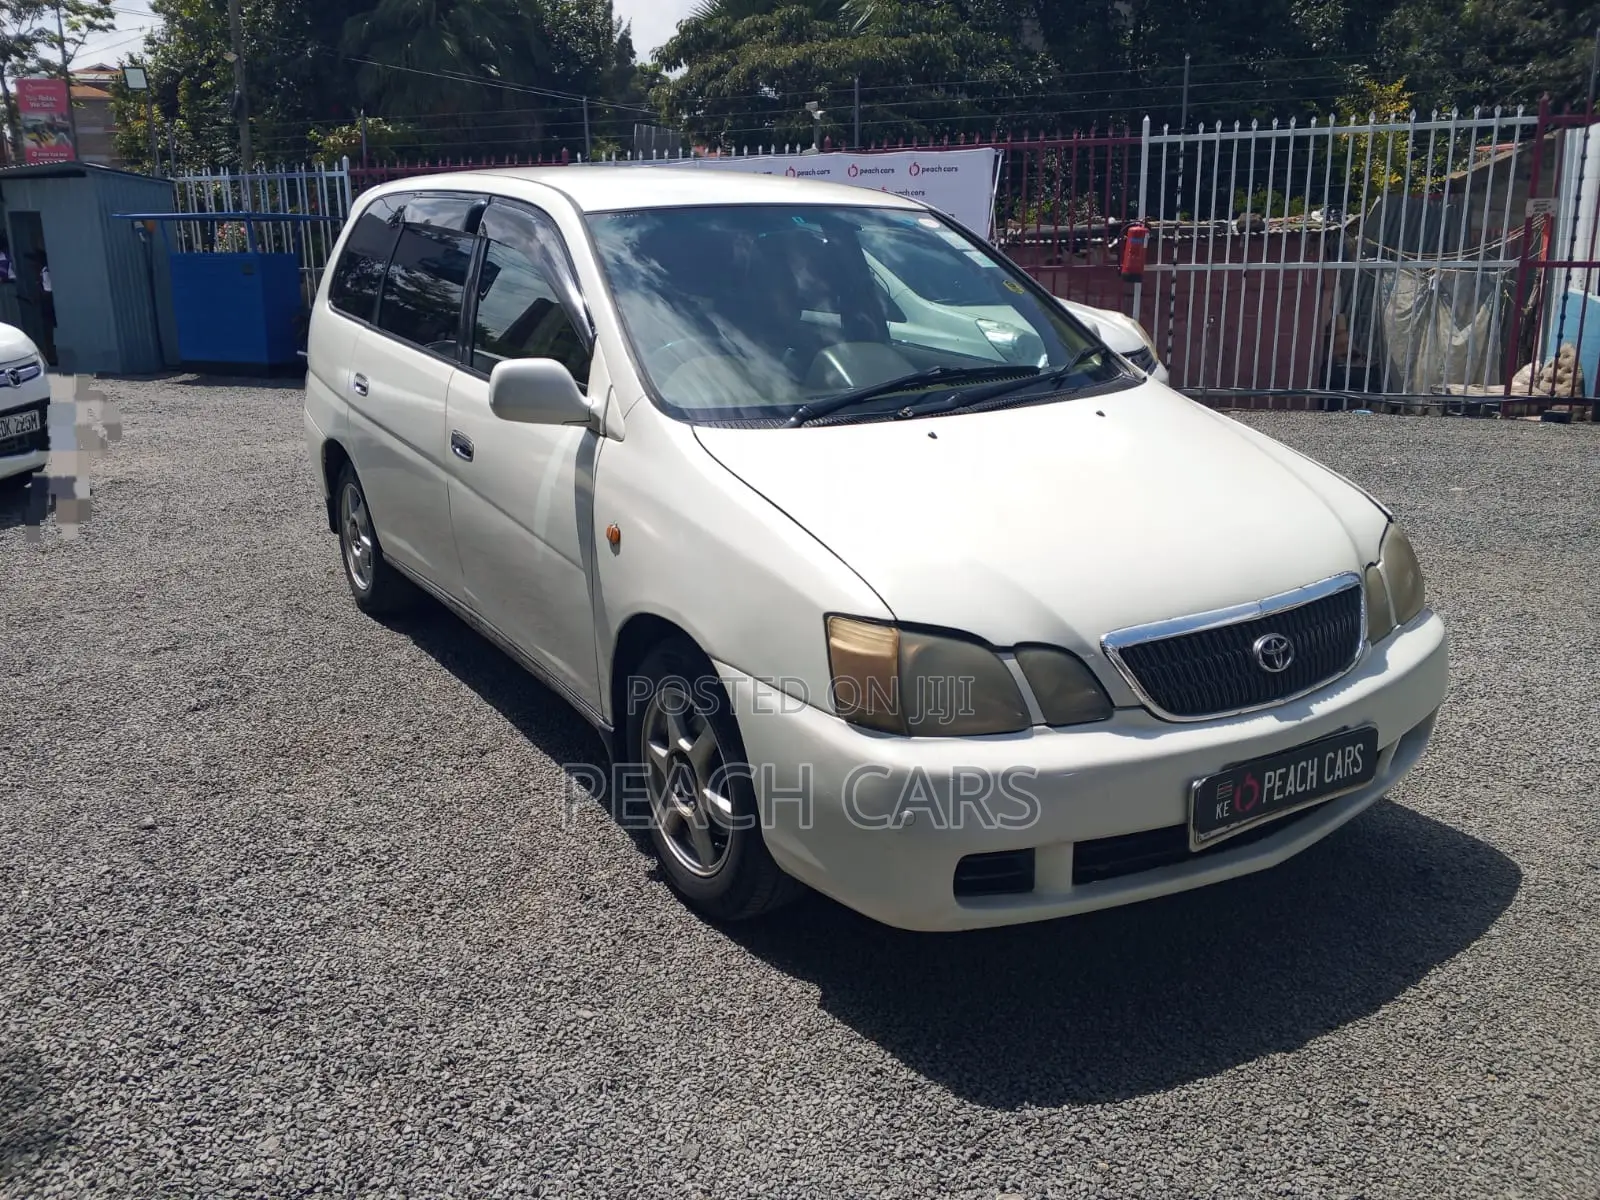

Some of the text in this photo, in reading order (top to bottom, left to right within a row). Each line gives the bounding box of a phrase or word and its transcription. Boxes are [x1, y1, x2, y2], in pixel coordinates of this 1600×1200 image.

[797, 169, 816, 178] peach
[860, 167, 880, 176] peach
[921, 166, 942, 176] peach
[0, 417, 12, 436] DK
[1263, 743, 1364, 803] PEACH CARS
[1215, 800, 1232, 820] KE
